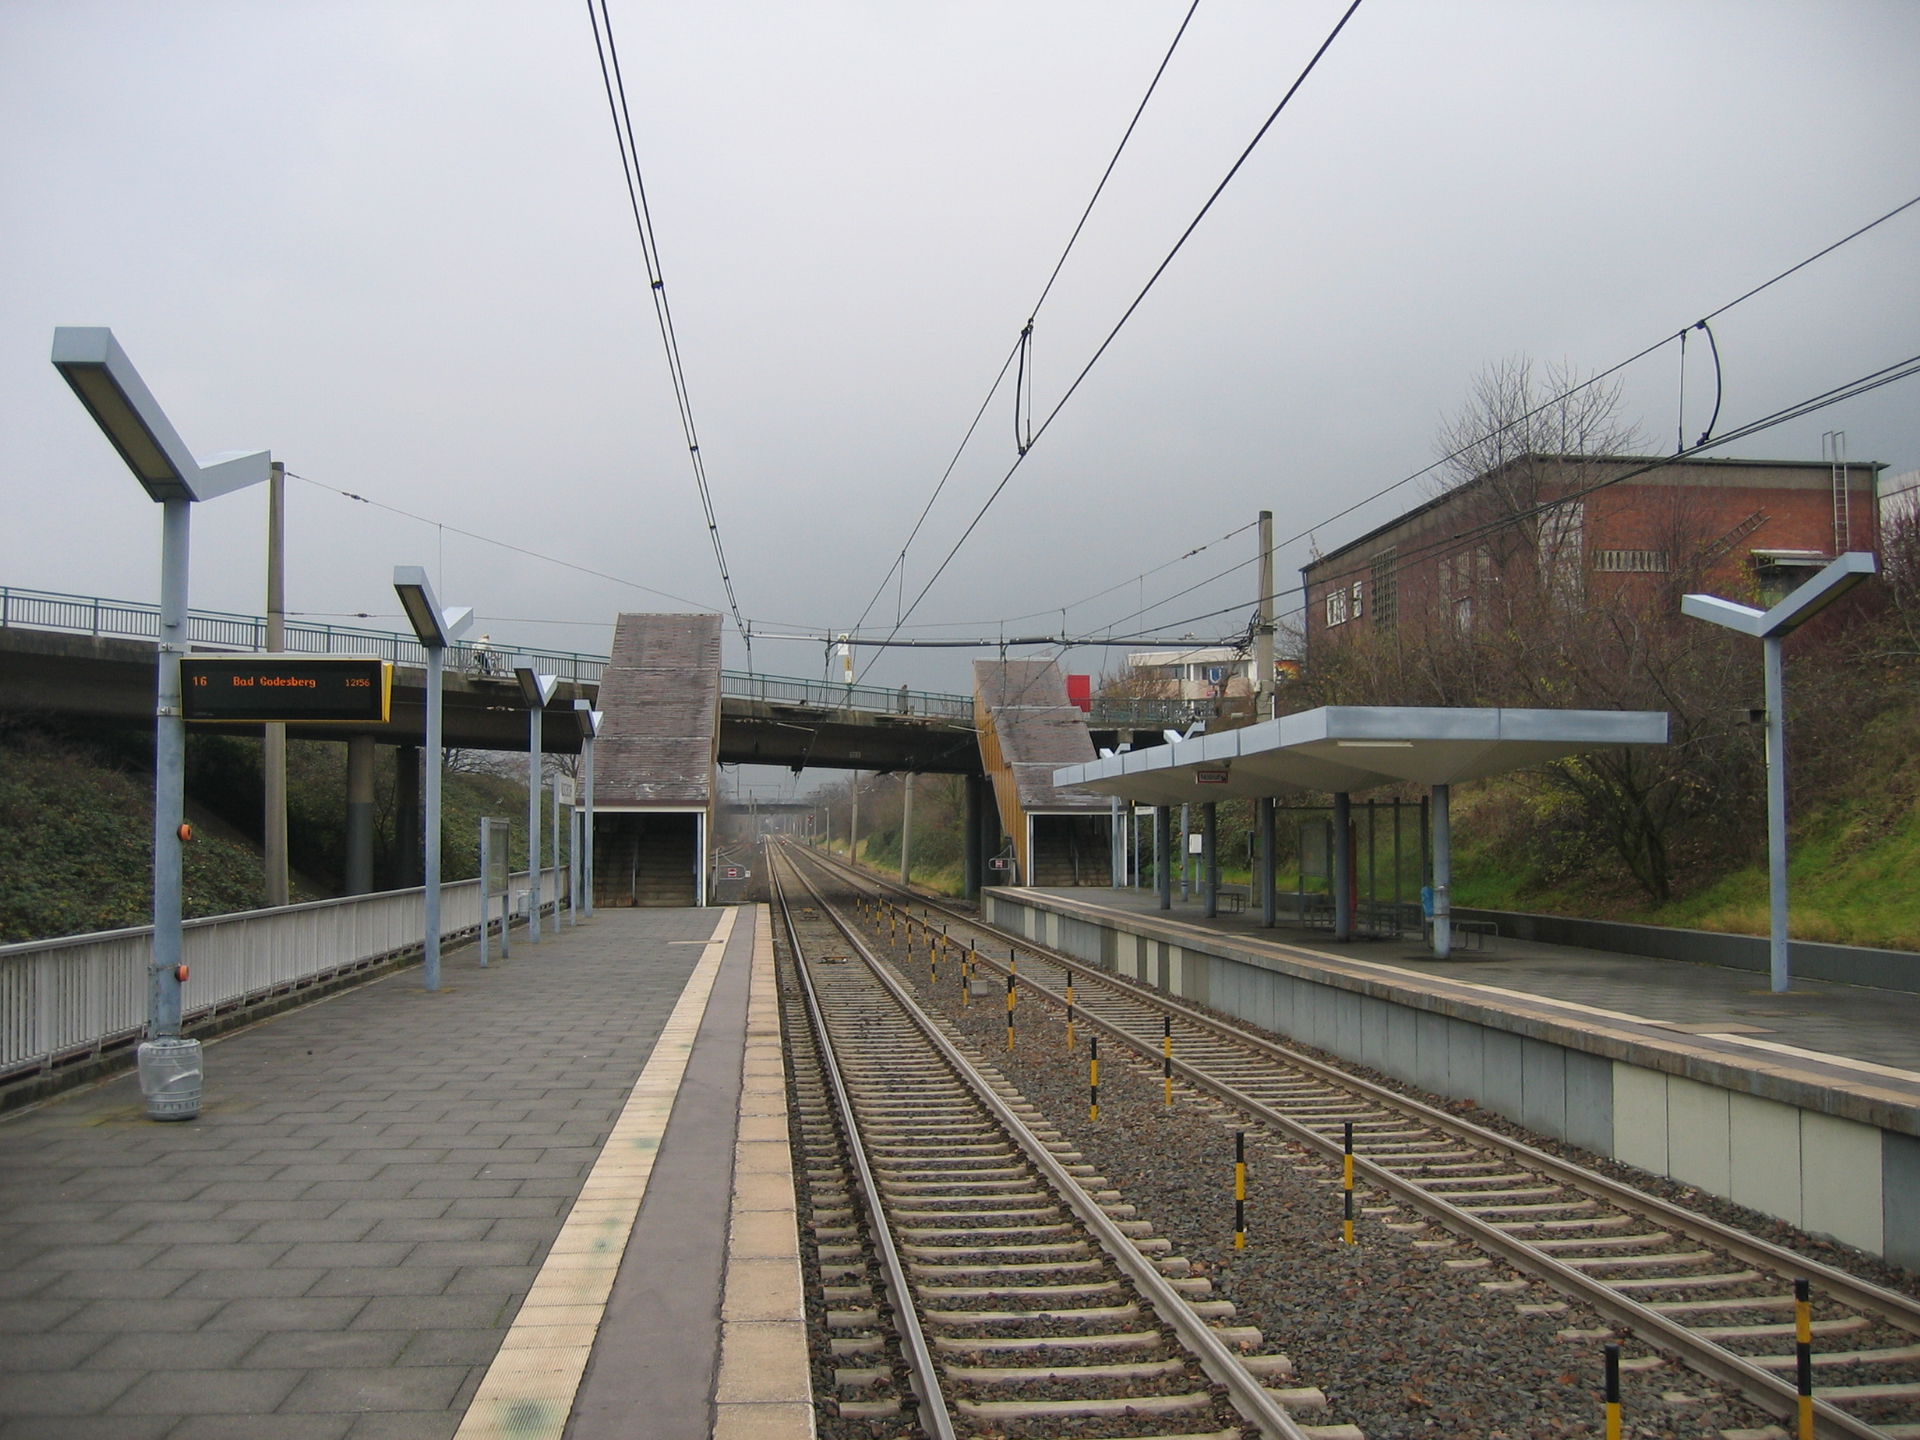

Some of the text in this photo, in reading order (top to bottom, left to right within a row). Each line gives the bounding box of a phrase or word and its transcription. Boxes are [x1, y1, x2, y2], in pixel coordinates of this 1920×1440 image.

[192, 676, 208, 687] 16
[233, 676, 255, 686] Bad
[260, 676, 317, 688] Godesberg
[1209, 667, 1222, 684] U
